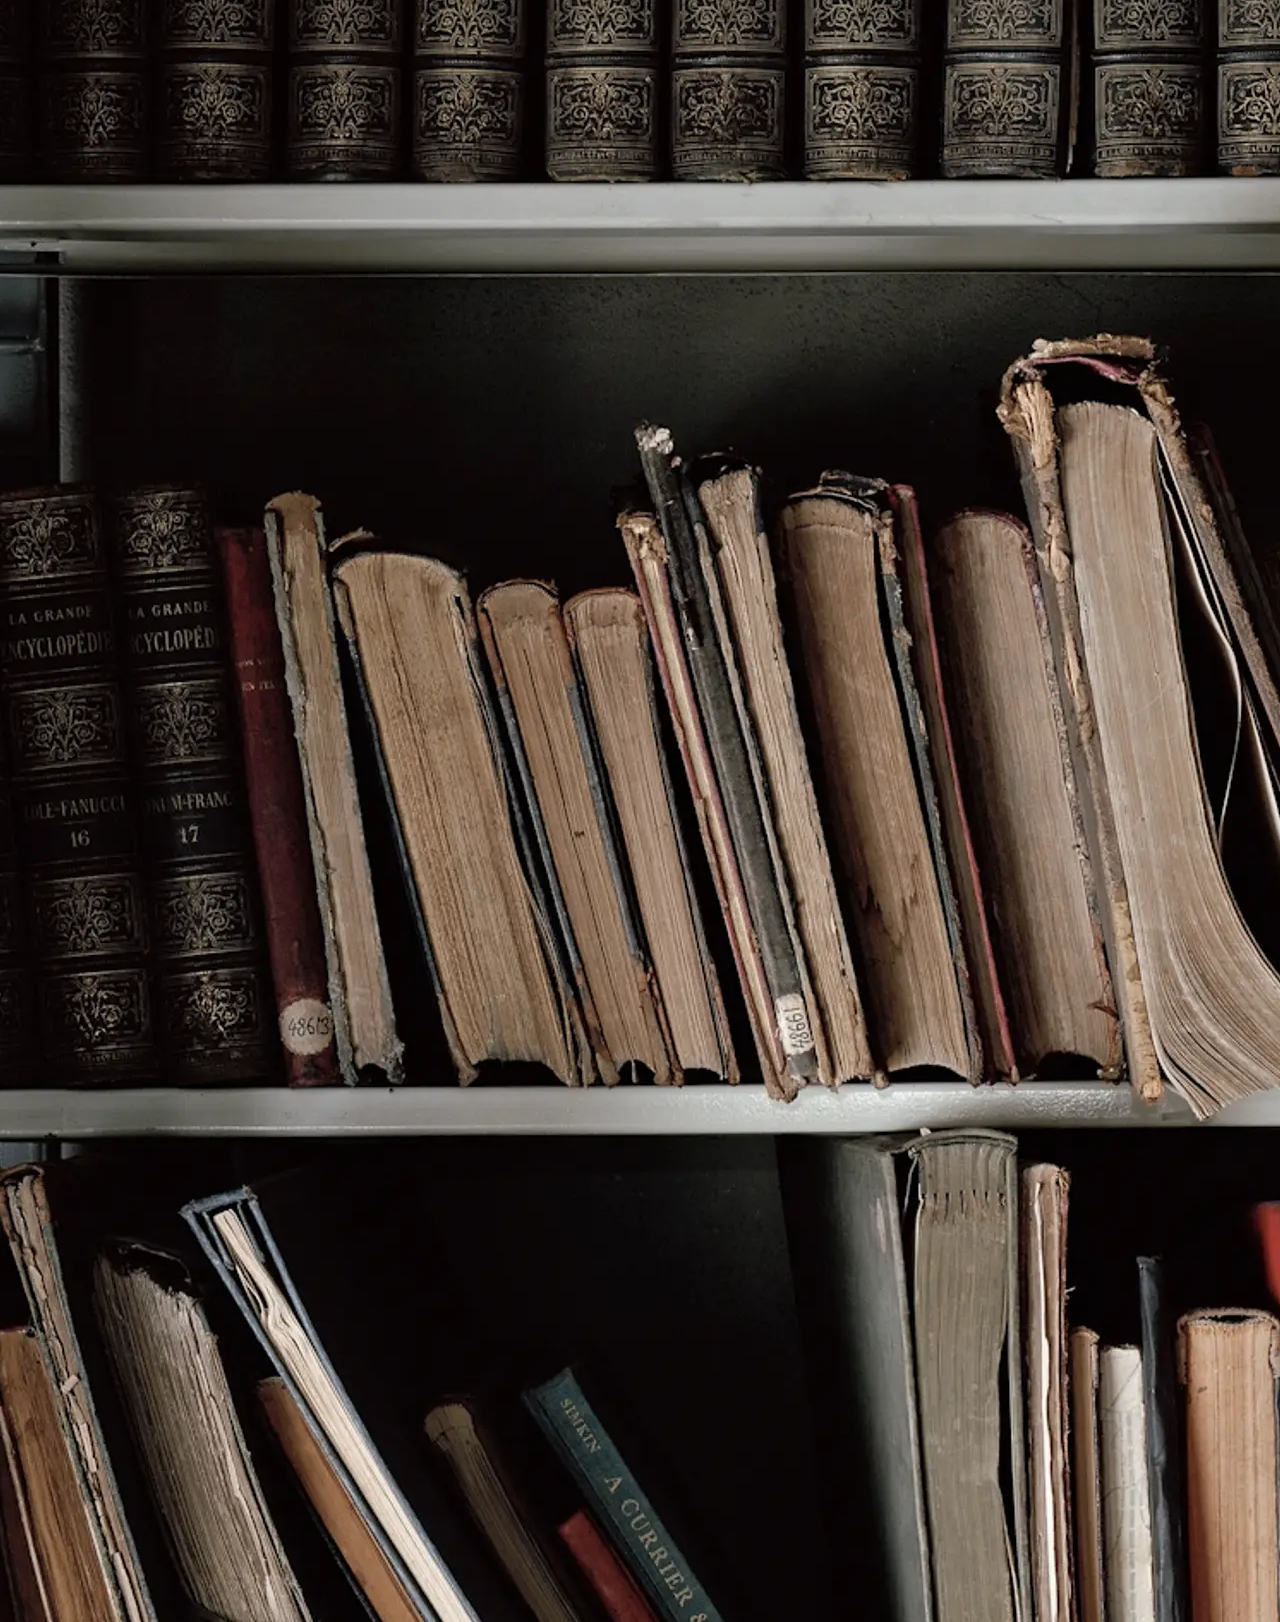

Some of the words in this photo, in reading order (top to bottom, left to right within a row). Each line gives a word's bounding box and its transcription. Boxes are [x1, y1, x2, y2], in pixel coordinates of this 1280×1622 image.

[9, 613, 27, 626] LA
[33, 605, 94, 623] GRANDE
[128, 606, 146, 620] LA
[151, 599, 214, 619] GRANDE
[69, 829, 92, 848] 16
[179, 823, 200, 845] 17
[288, 1016, 329, 1038] 48613
[784, 1008, 811, 1047] 48661
[560, 1398, 601, 1454] SIMKIN
[604, 1475, 623, 1493] A
[621, 1499, 693, 1607] CURRIER
